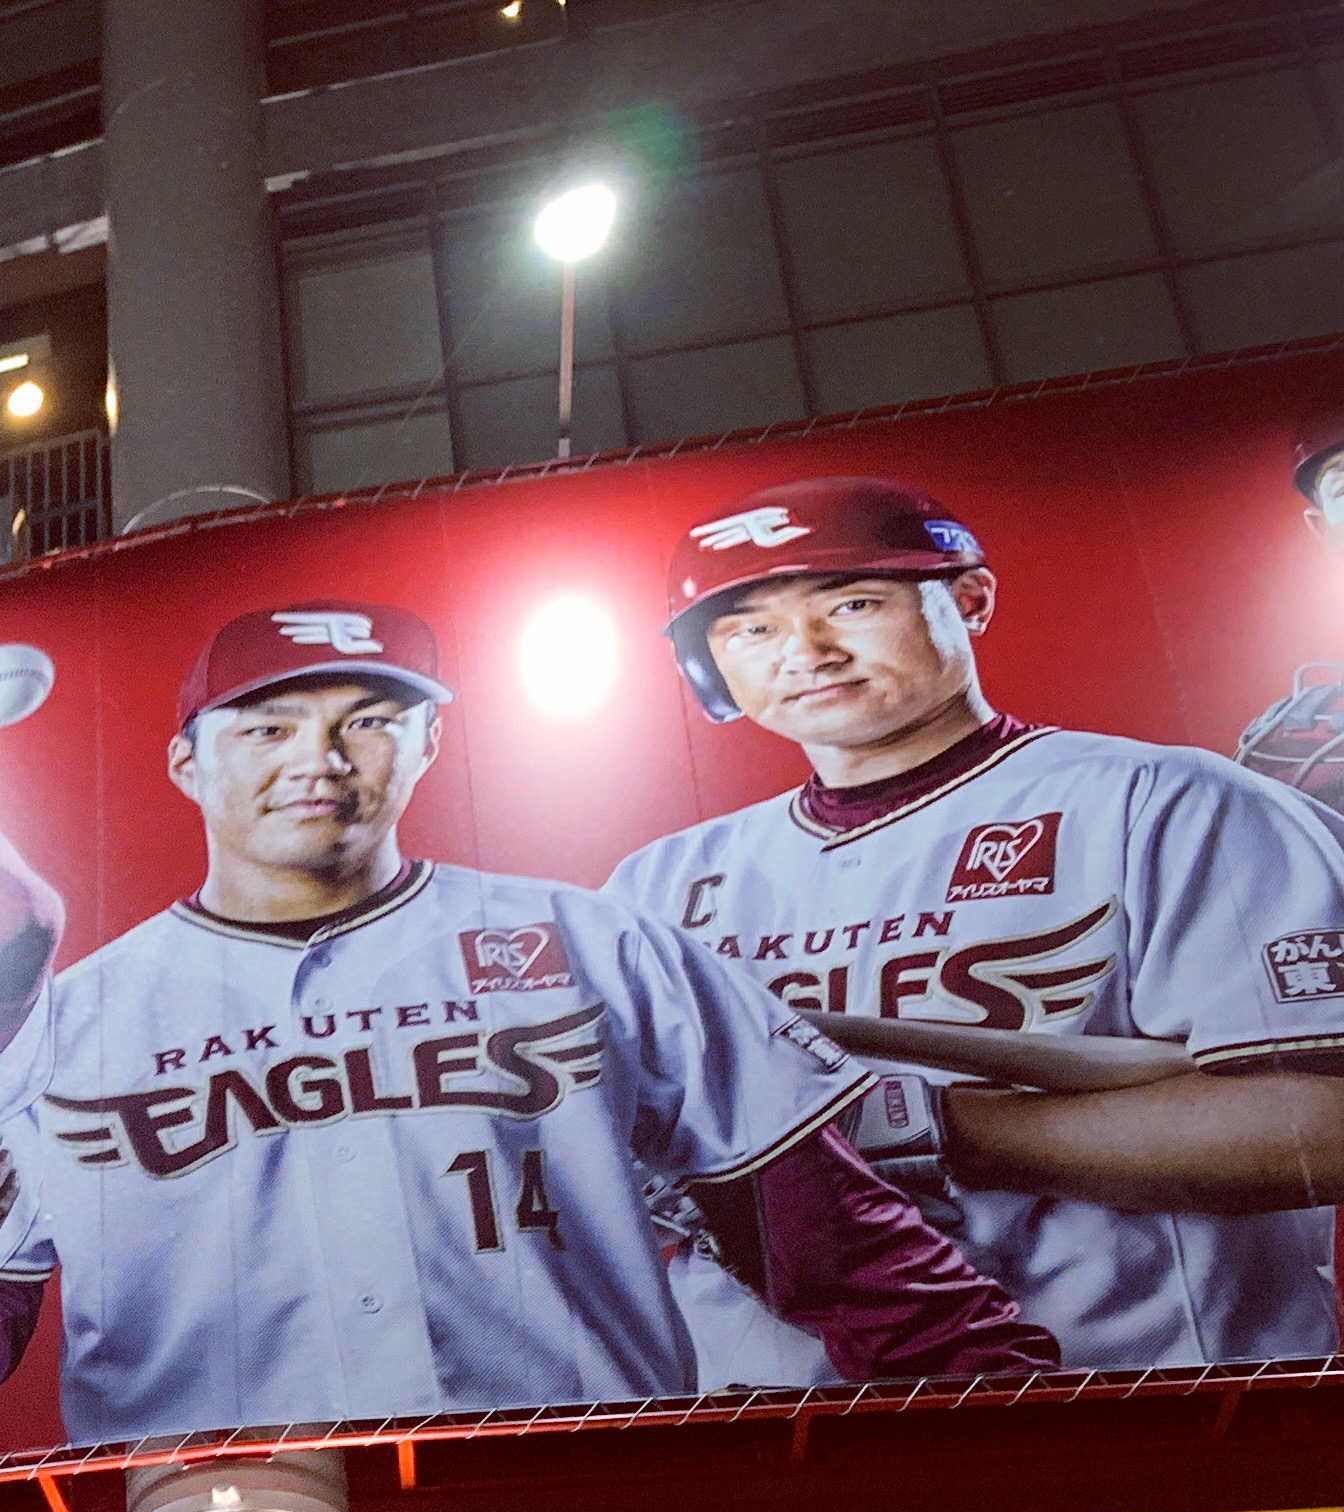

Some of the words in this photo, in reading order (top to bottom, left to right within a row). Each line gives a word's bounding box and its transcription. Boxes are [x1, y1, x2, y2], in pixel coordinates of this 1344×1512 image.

[681, 874, 726, 929] C
[703, 911, 954, 961] AKUTEN
[1270, 936, 1344, 965] がん
[154, 1000, 482, 1076] RAKUTEN
[45, 1002, 606, 1180] EAGLES
[440, 1150, 566, 1254] 14
